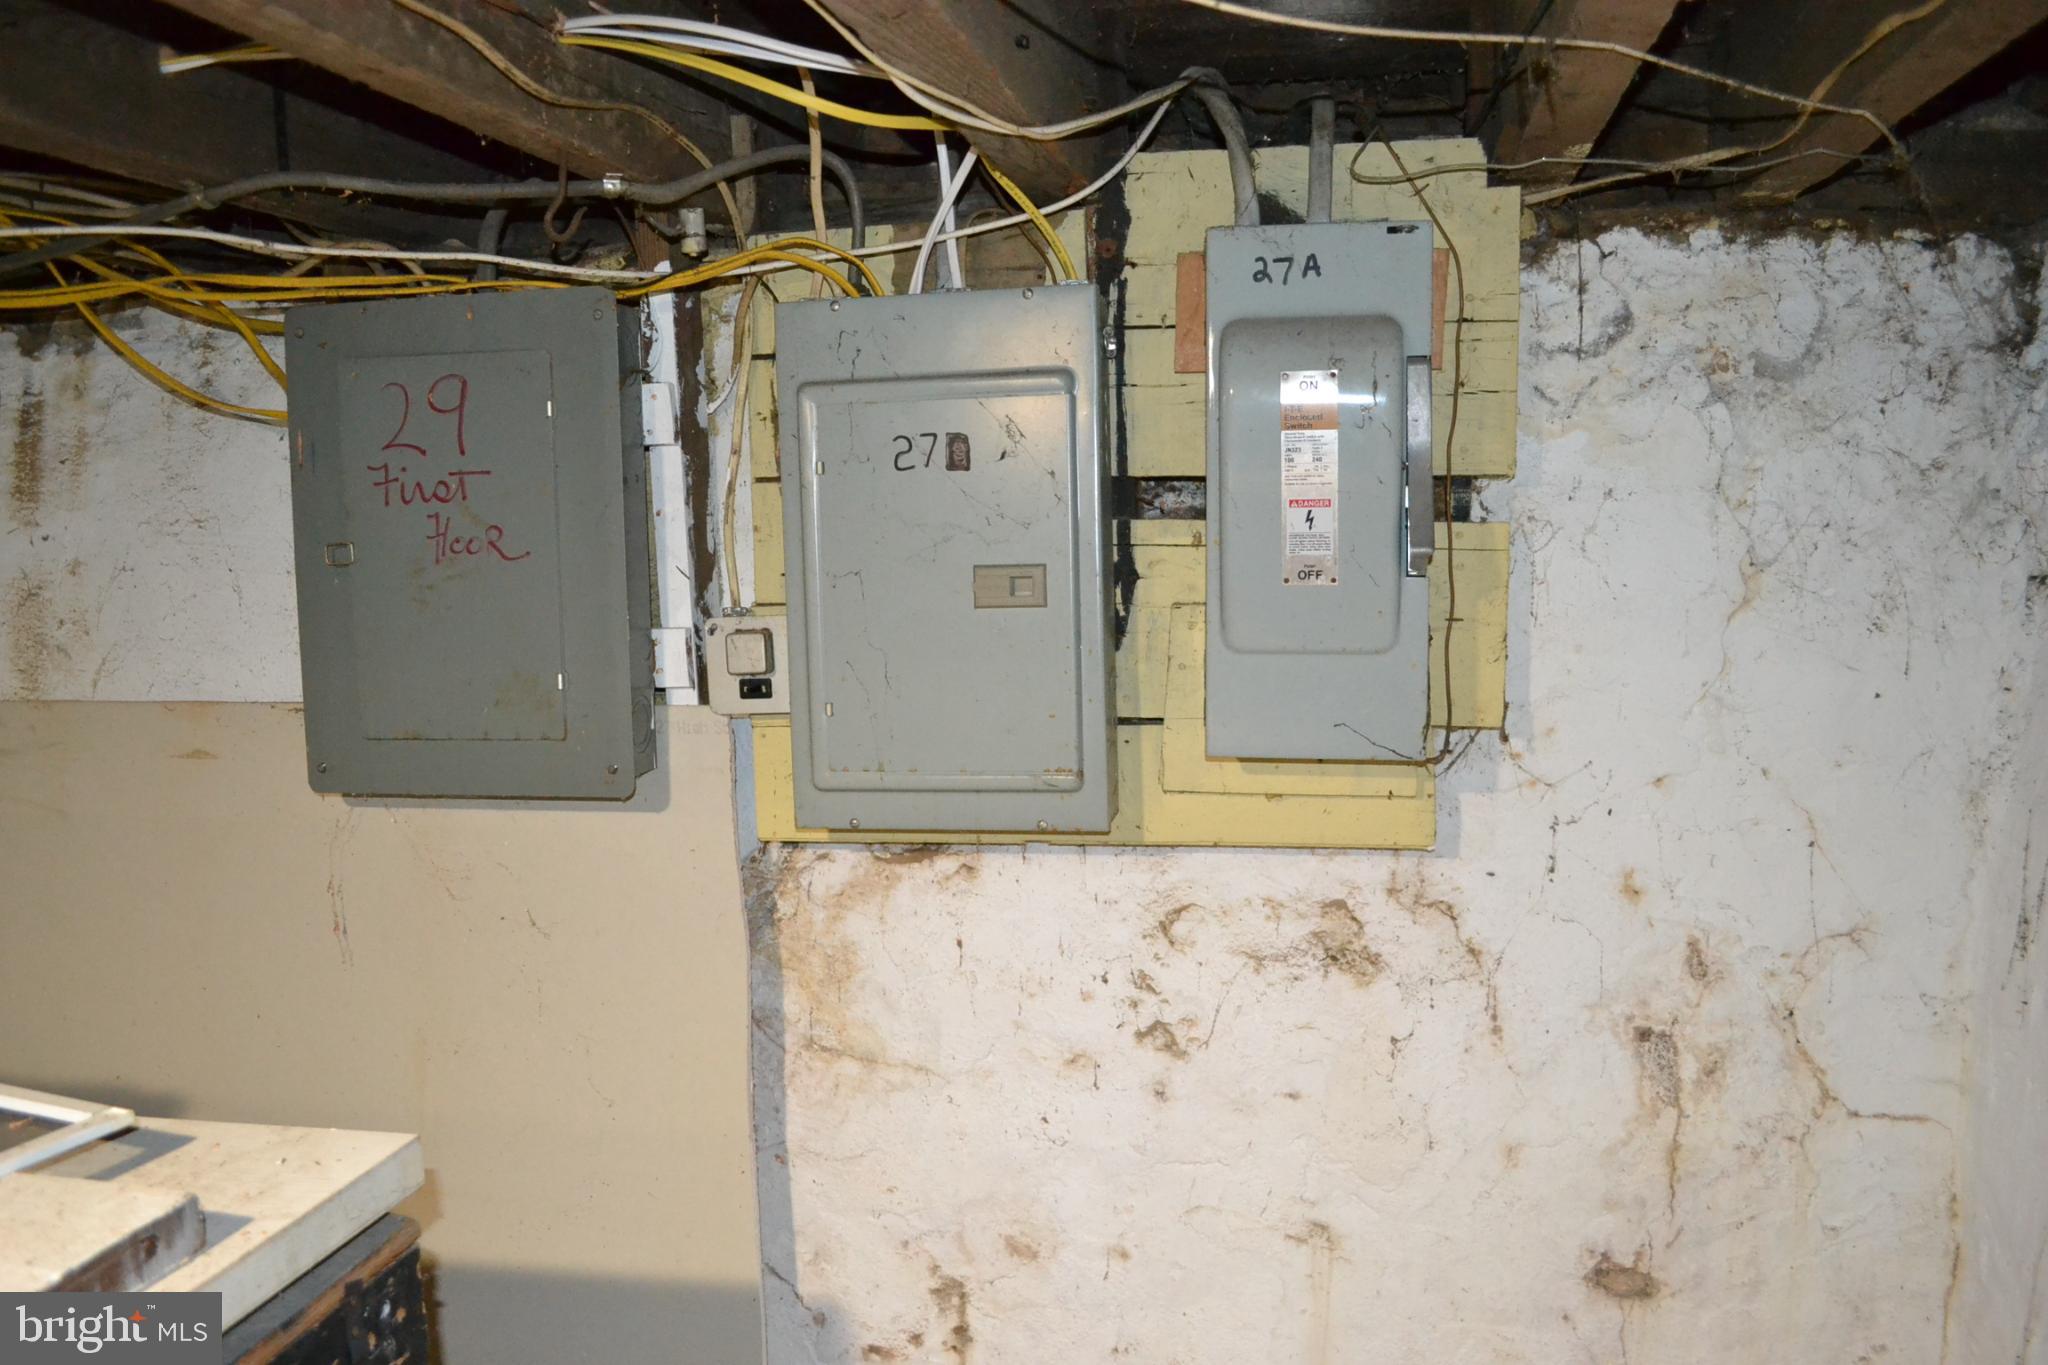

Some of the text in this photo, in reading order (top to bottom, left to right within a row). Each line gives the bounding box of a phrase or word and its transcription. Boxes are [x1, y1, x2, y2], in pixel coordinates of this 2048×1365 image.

[1299, 380, 1318, 390] ON
[381, 373, 468, 457] 29
[1298, 499, 1329, 507] DANGER
[1297, 570, 1324, 580] OFF
